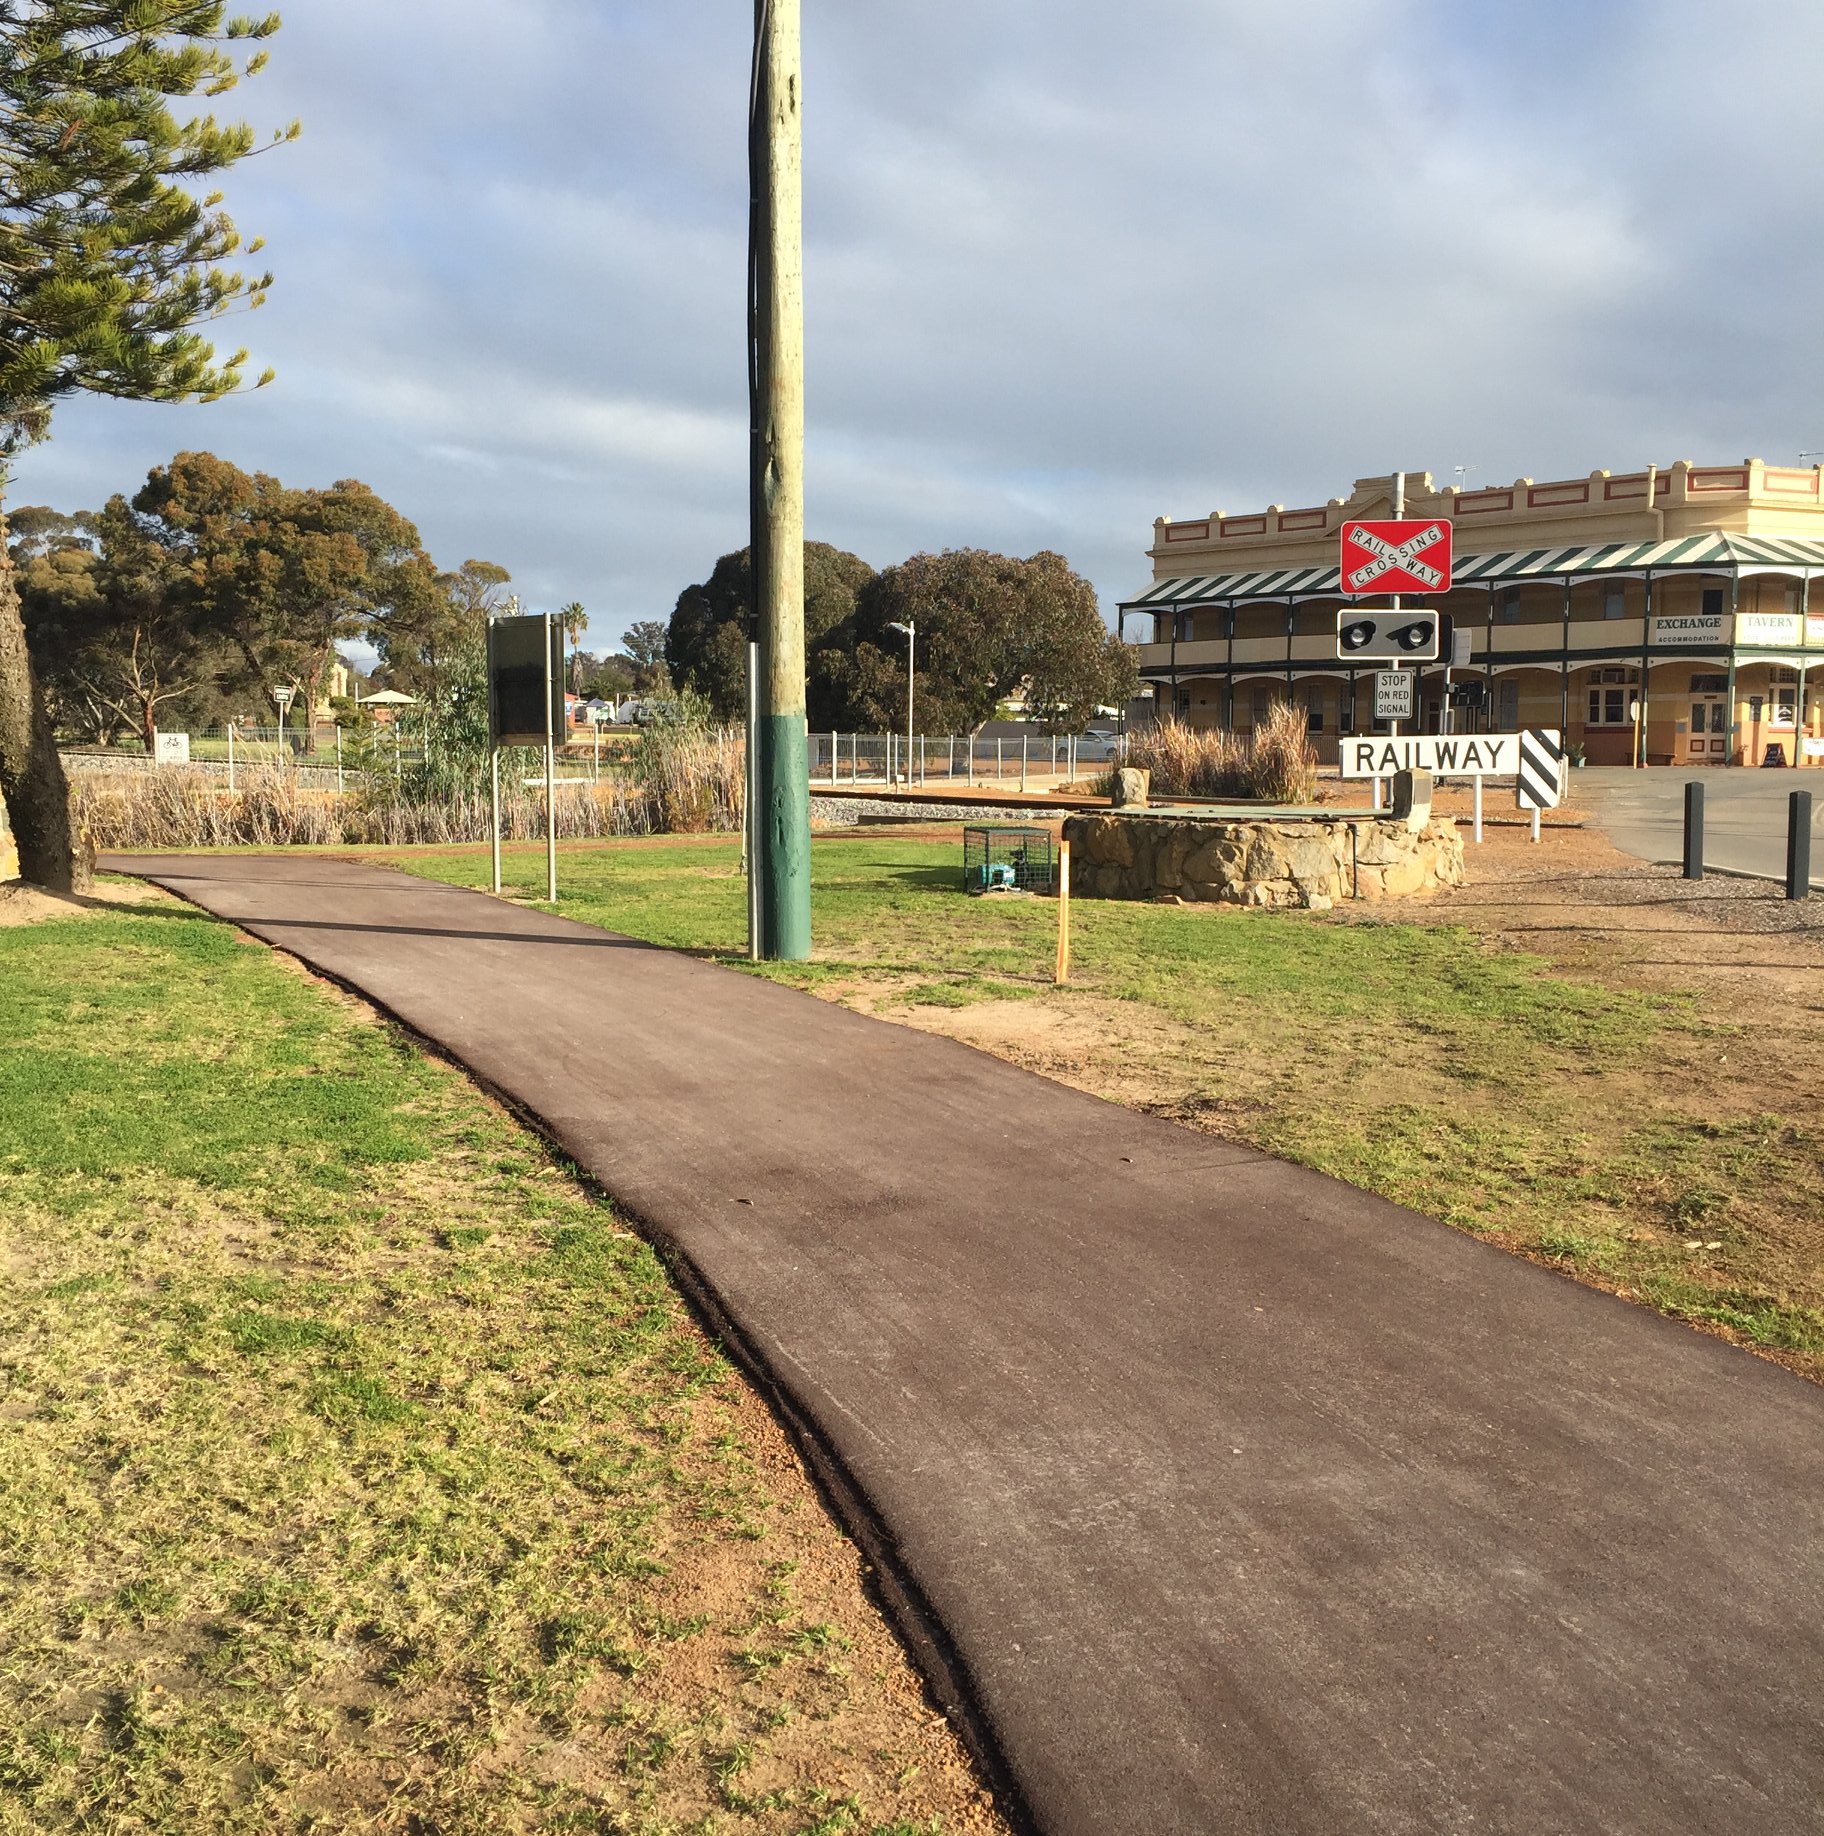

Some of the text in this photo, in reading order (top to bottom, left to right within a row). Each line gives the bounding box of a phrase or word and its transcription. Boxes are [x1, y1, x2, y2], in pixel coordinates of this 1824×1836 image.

[1355, 530, 1437, 583] CROSSING
[1656, 617, 1721, 629] EXCHANGE
[1747, 616, 1793, 627] TAVERN
[1381, 675, 1407, 686] STOP
[1378, 690, 1409, 700] ON RED
[1378, 704, 1409, 713] SIGNAL
[1356, 740, 1505, 772] RAILWAY
